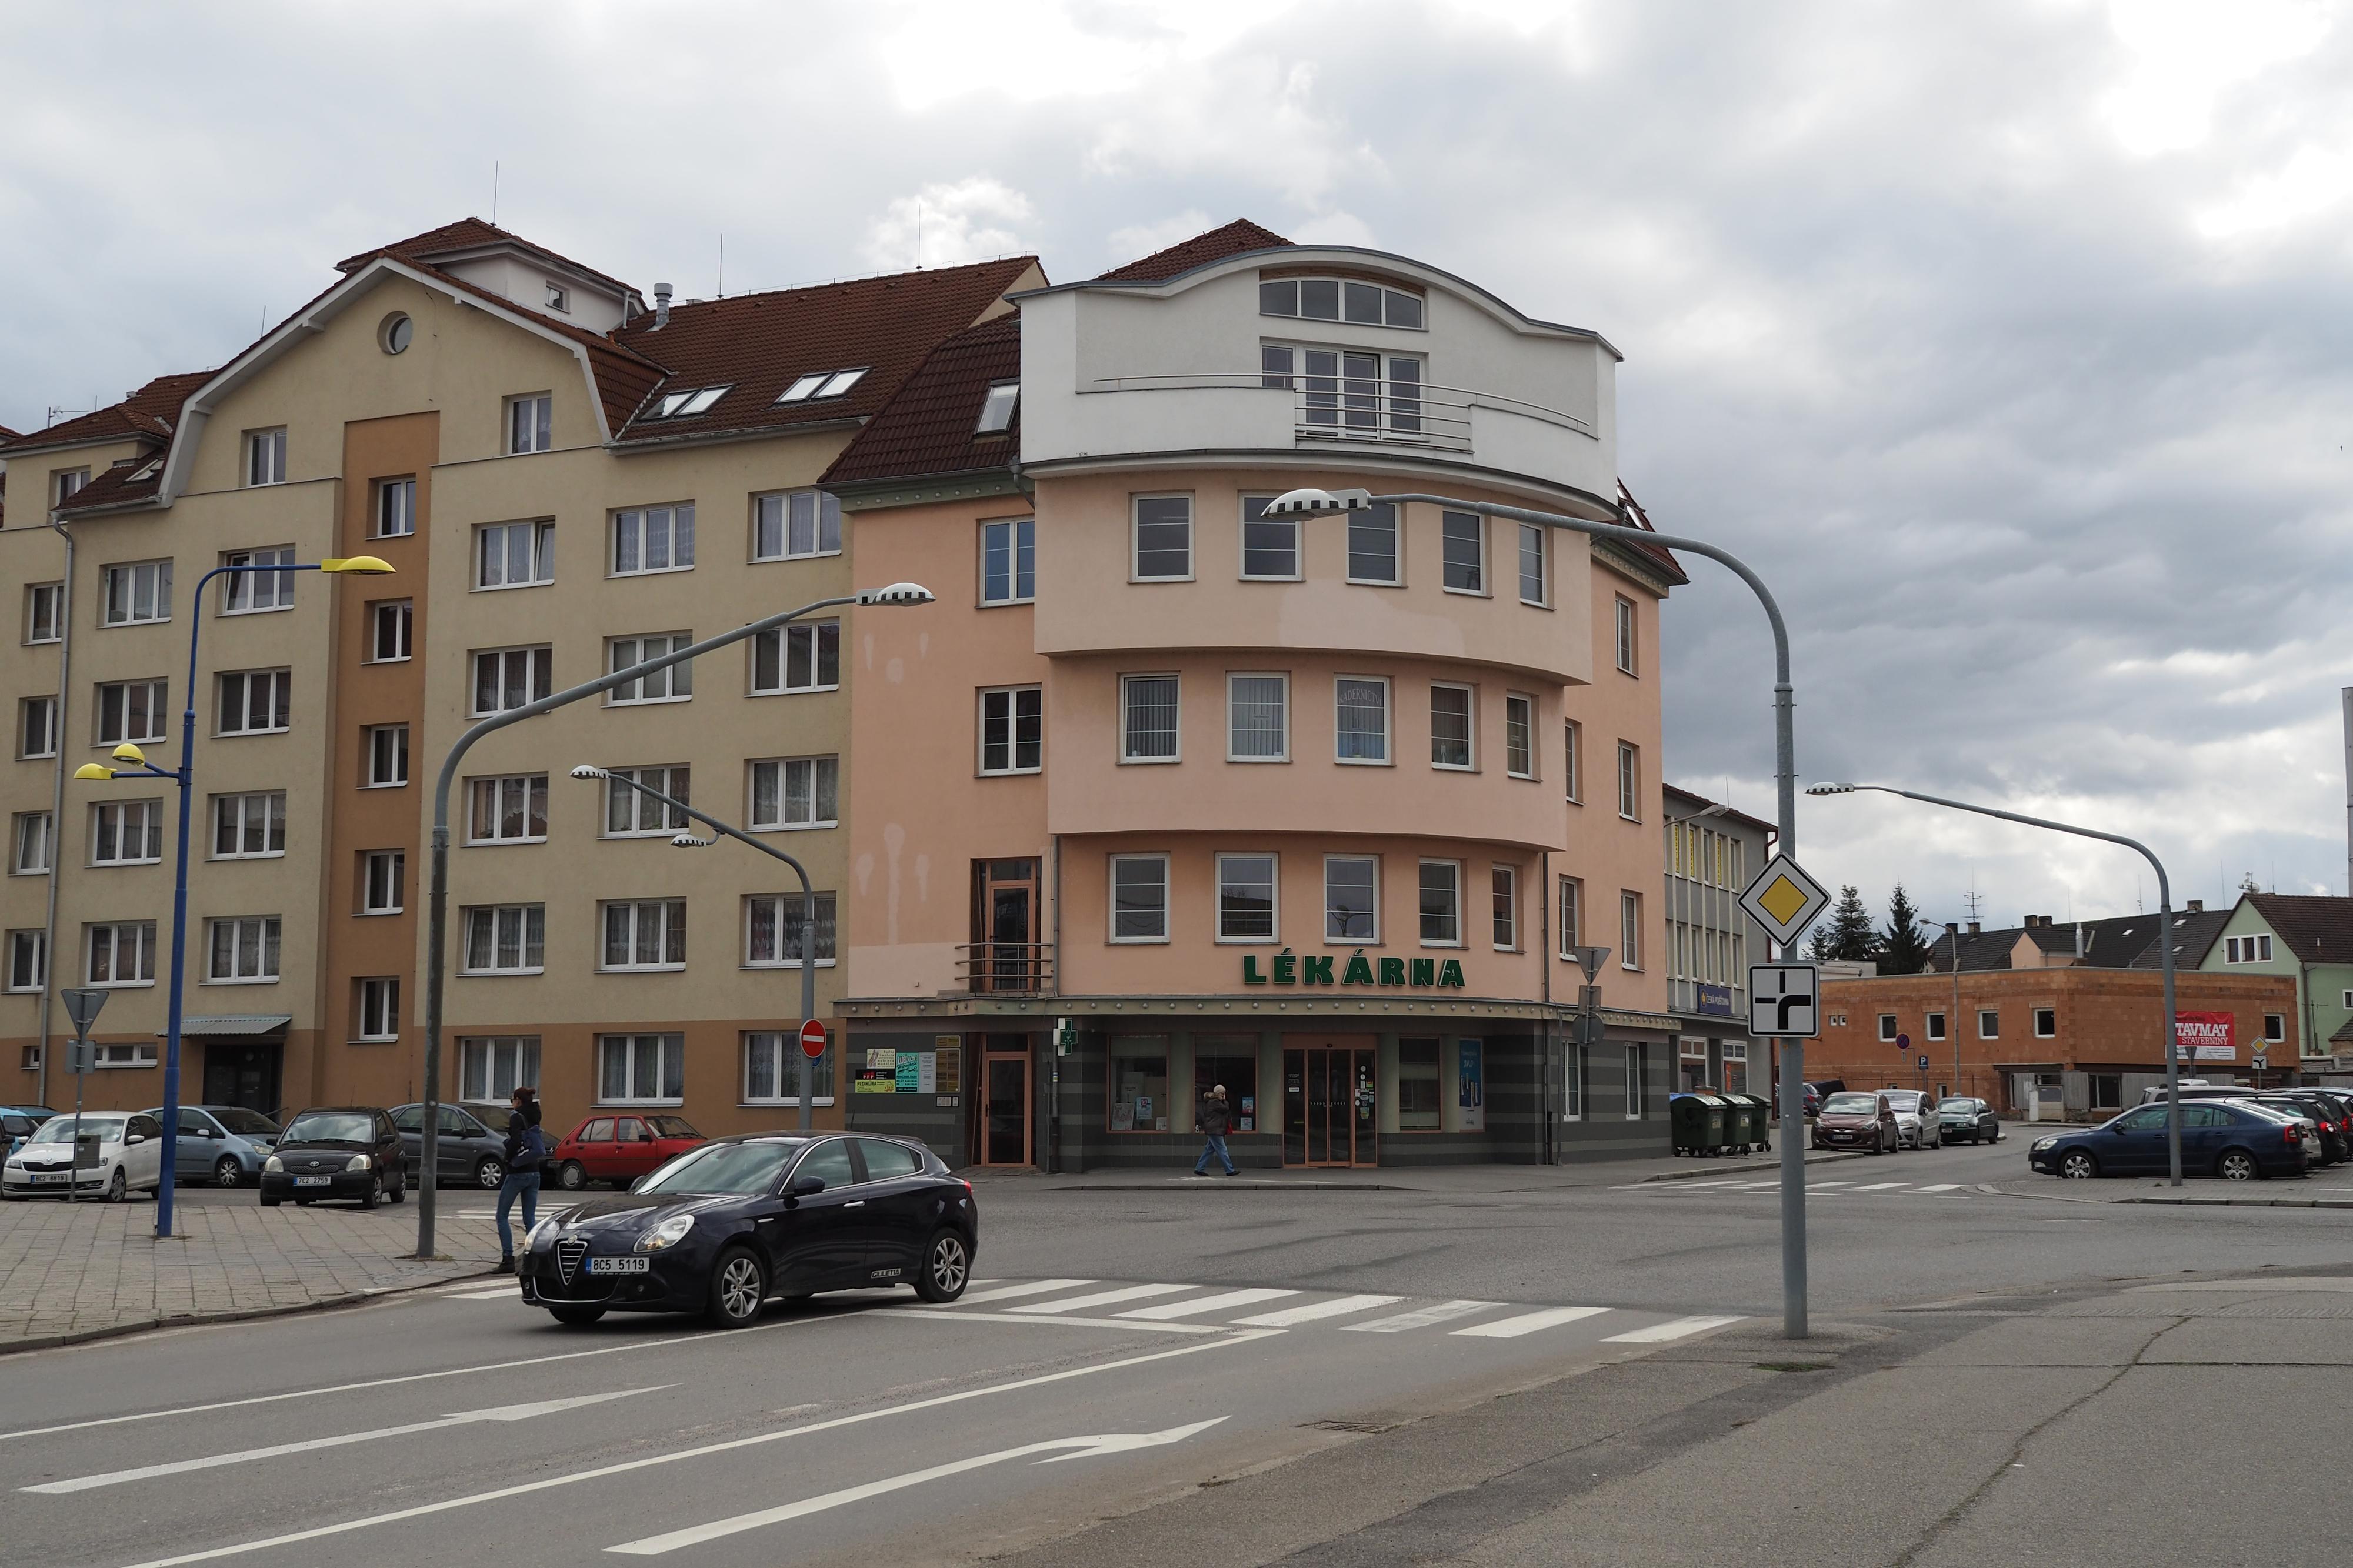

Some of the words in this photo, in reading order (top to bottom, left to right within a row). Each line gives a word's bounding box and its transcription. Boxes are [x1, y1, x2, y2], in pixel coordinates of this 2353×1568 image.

[1242, 947, 1466, 987] LÉKÁRNA
[2175, 1022, 2228, 1037] TAVMAT
[2181, 1036, 2228, 1045] STAVEBNINY
[594, 1259, 611, 1270] 8C5
[619, 1259, 644, 1270] 5119
